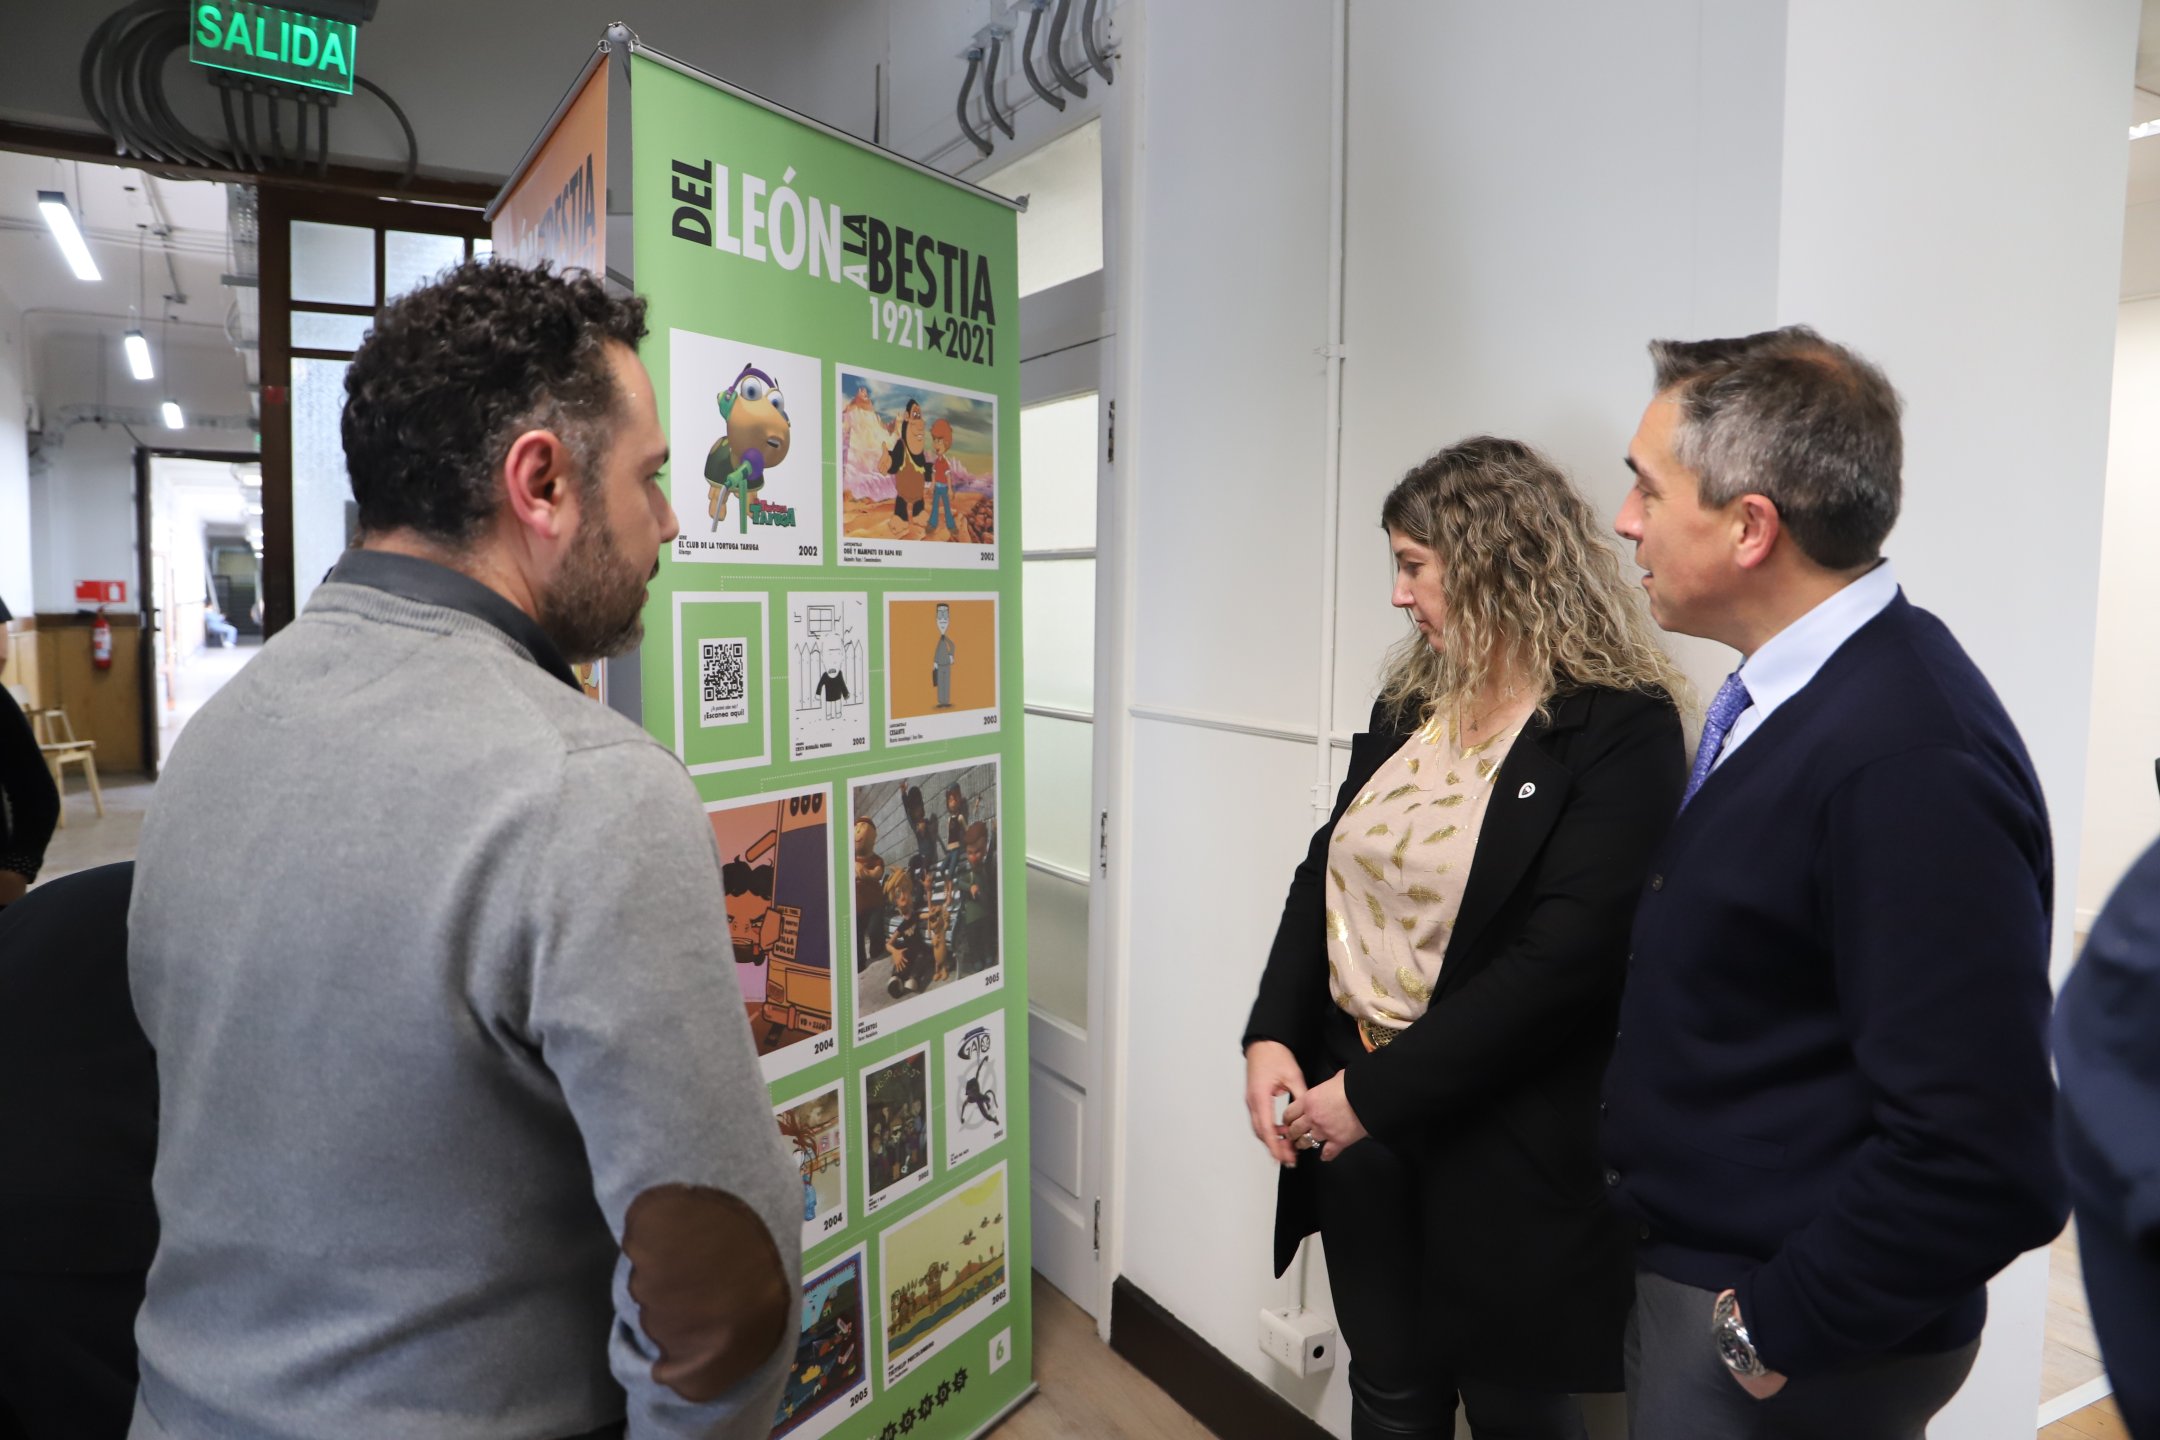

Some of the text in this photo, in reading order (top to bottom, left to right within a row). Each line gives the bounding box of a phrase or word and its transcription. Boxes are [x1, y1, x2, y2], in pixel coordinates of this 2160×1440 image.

[196, 5, 348, 75] SALIDA
[672, 159, 996, 326] DEL LEÓN A LA BESTIA
[869, 296, 994, 367] 1921 2021
[708, 542, 715, 550] LA
[798, 546, 818, 556] 2002
[980, 552, 995, 561] 2002
[984, 715, 998, 726] 2003
[852, 737, 866, 746] 2002
[985, 972, 1000, 986] 2005
[814, 1038, 834, 1054] 2004
[824, 1212, 843, 1232] 2004
[996, 1340, 1004, 1361] 6
[850, 1388, 868, 1408] 2005
